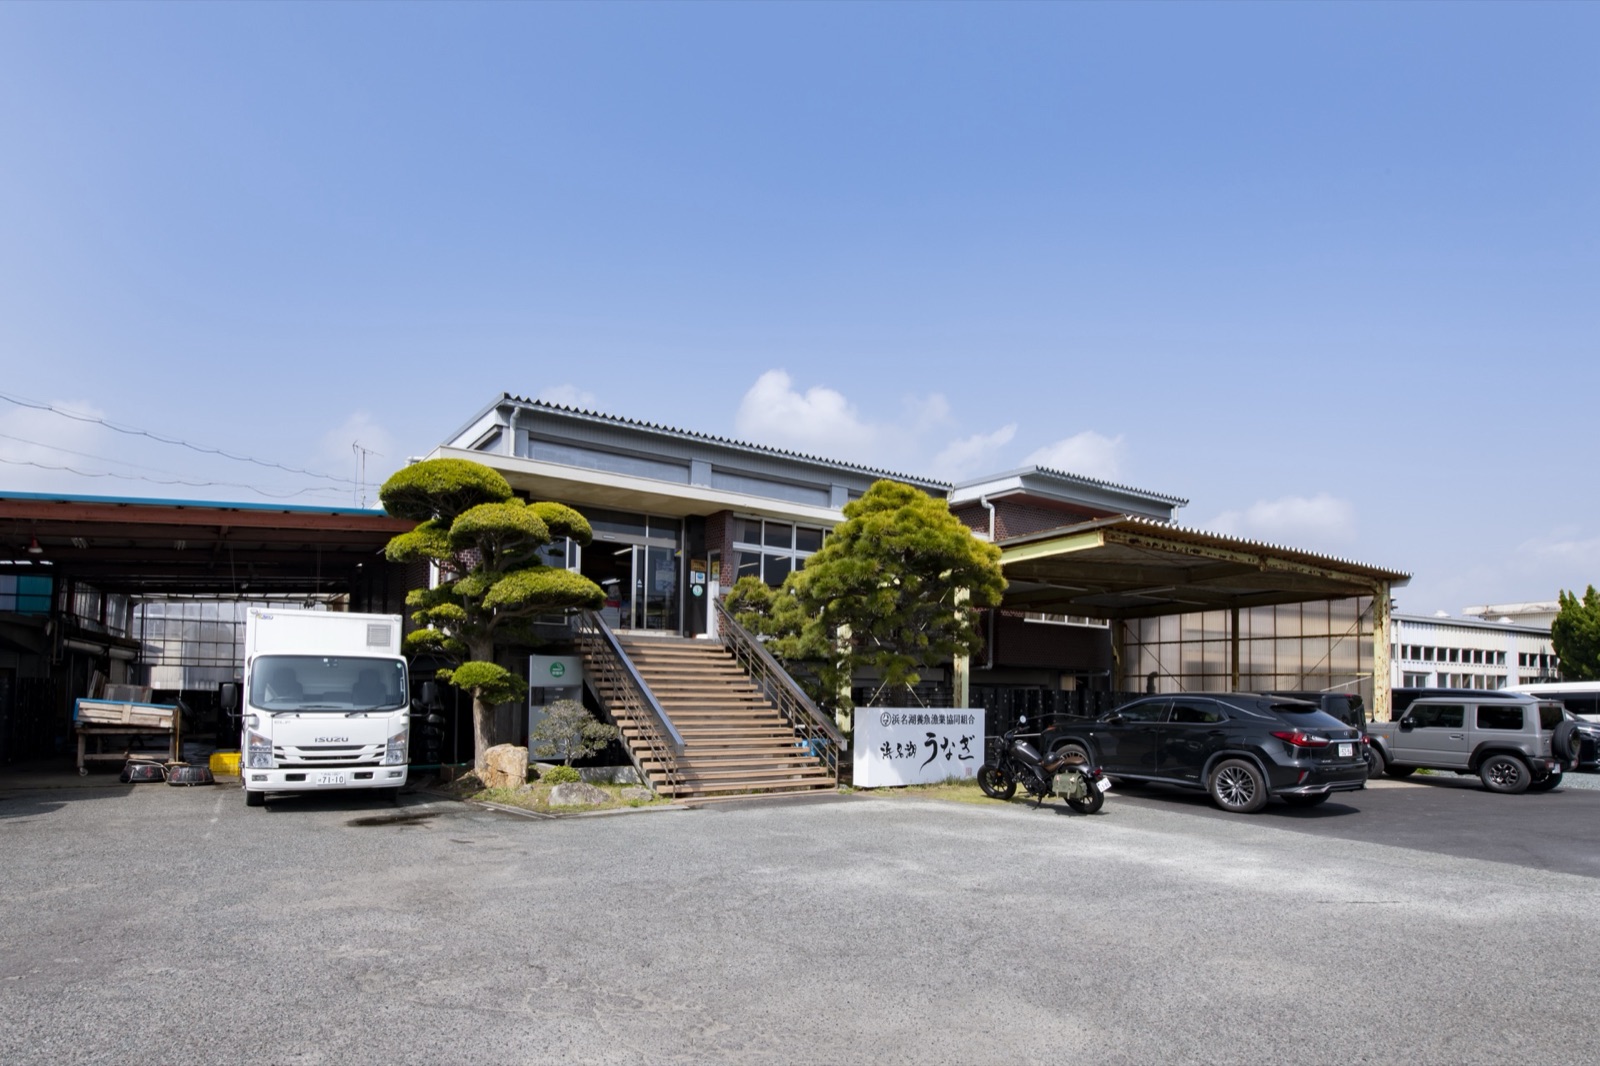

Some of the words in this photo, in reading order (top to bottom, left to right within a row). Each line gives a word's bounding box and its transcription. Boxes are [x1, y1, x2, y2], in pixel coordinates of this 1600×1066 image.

[891, 713, 975, 726] 浜名湖養魚漁業協同組合
[880, 741, 917, 760] 浜名湖
[919, 732, 976, 774] うなぎ
[322, 776, 344, 784] 71-10
